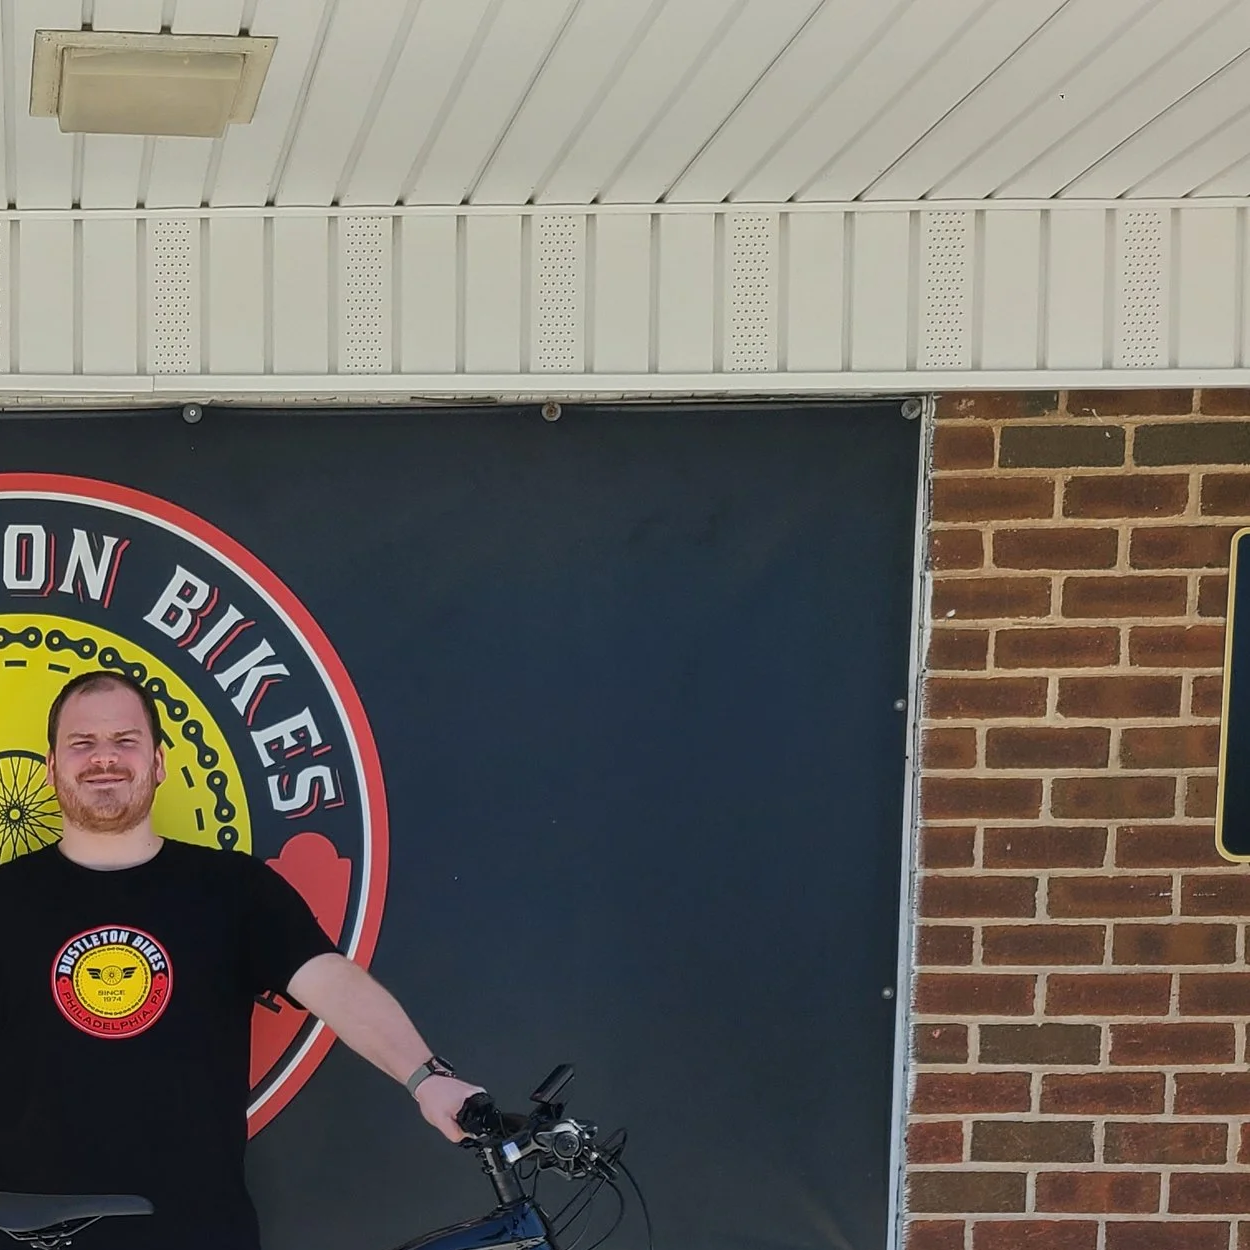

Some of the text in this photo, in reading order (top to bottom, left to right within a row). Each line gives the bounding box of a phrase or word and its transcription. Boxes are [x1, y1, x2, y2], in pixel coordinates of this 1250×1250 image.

[143, 565, 340, 814] BIKES
[58, 930, 165, 975] BUSTLETON BIKES
[151, 988, 163, 1004] PA
